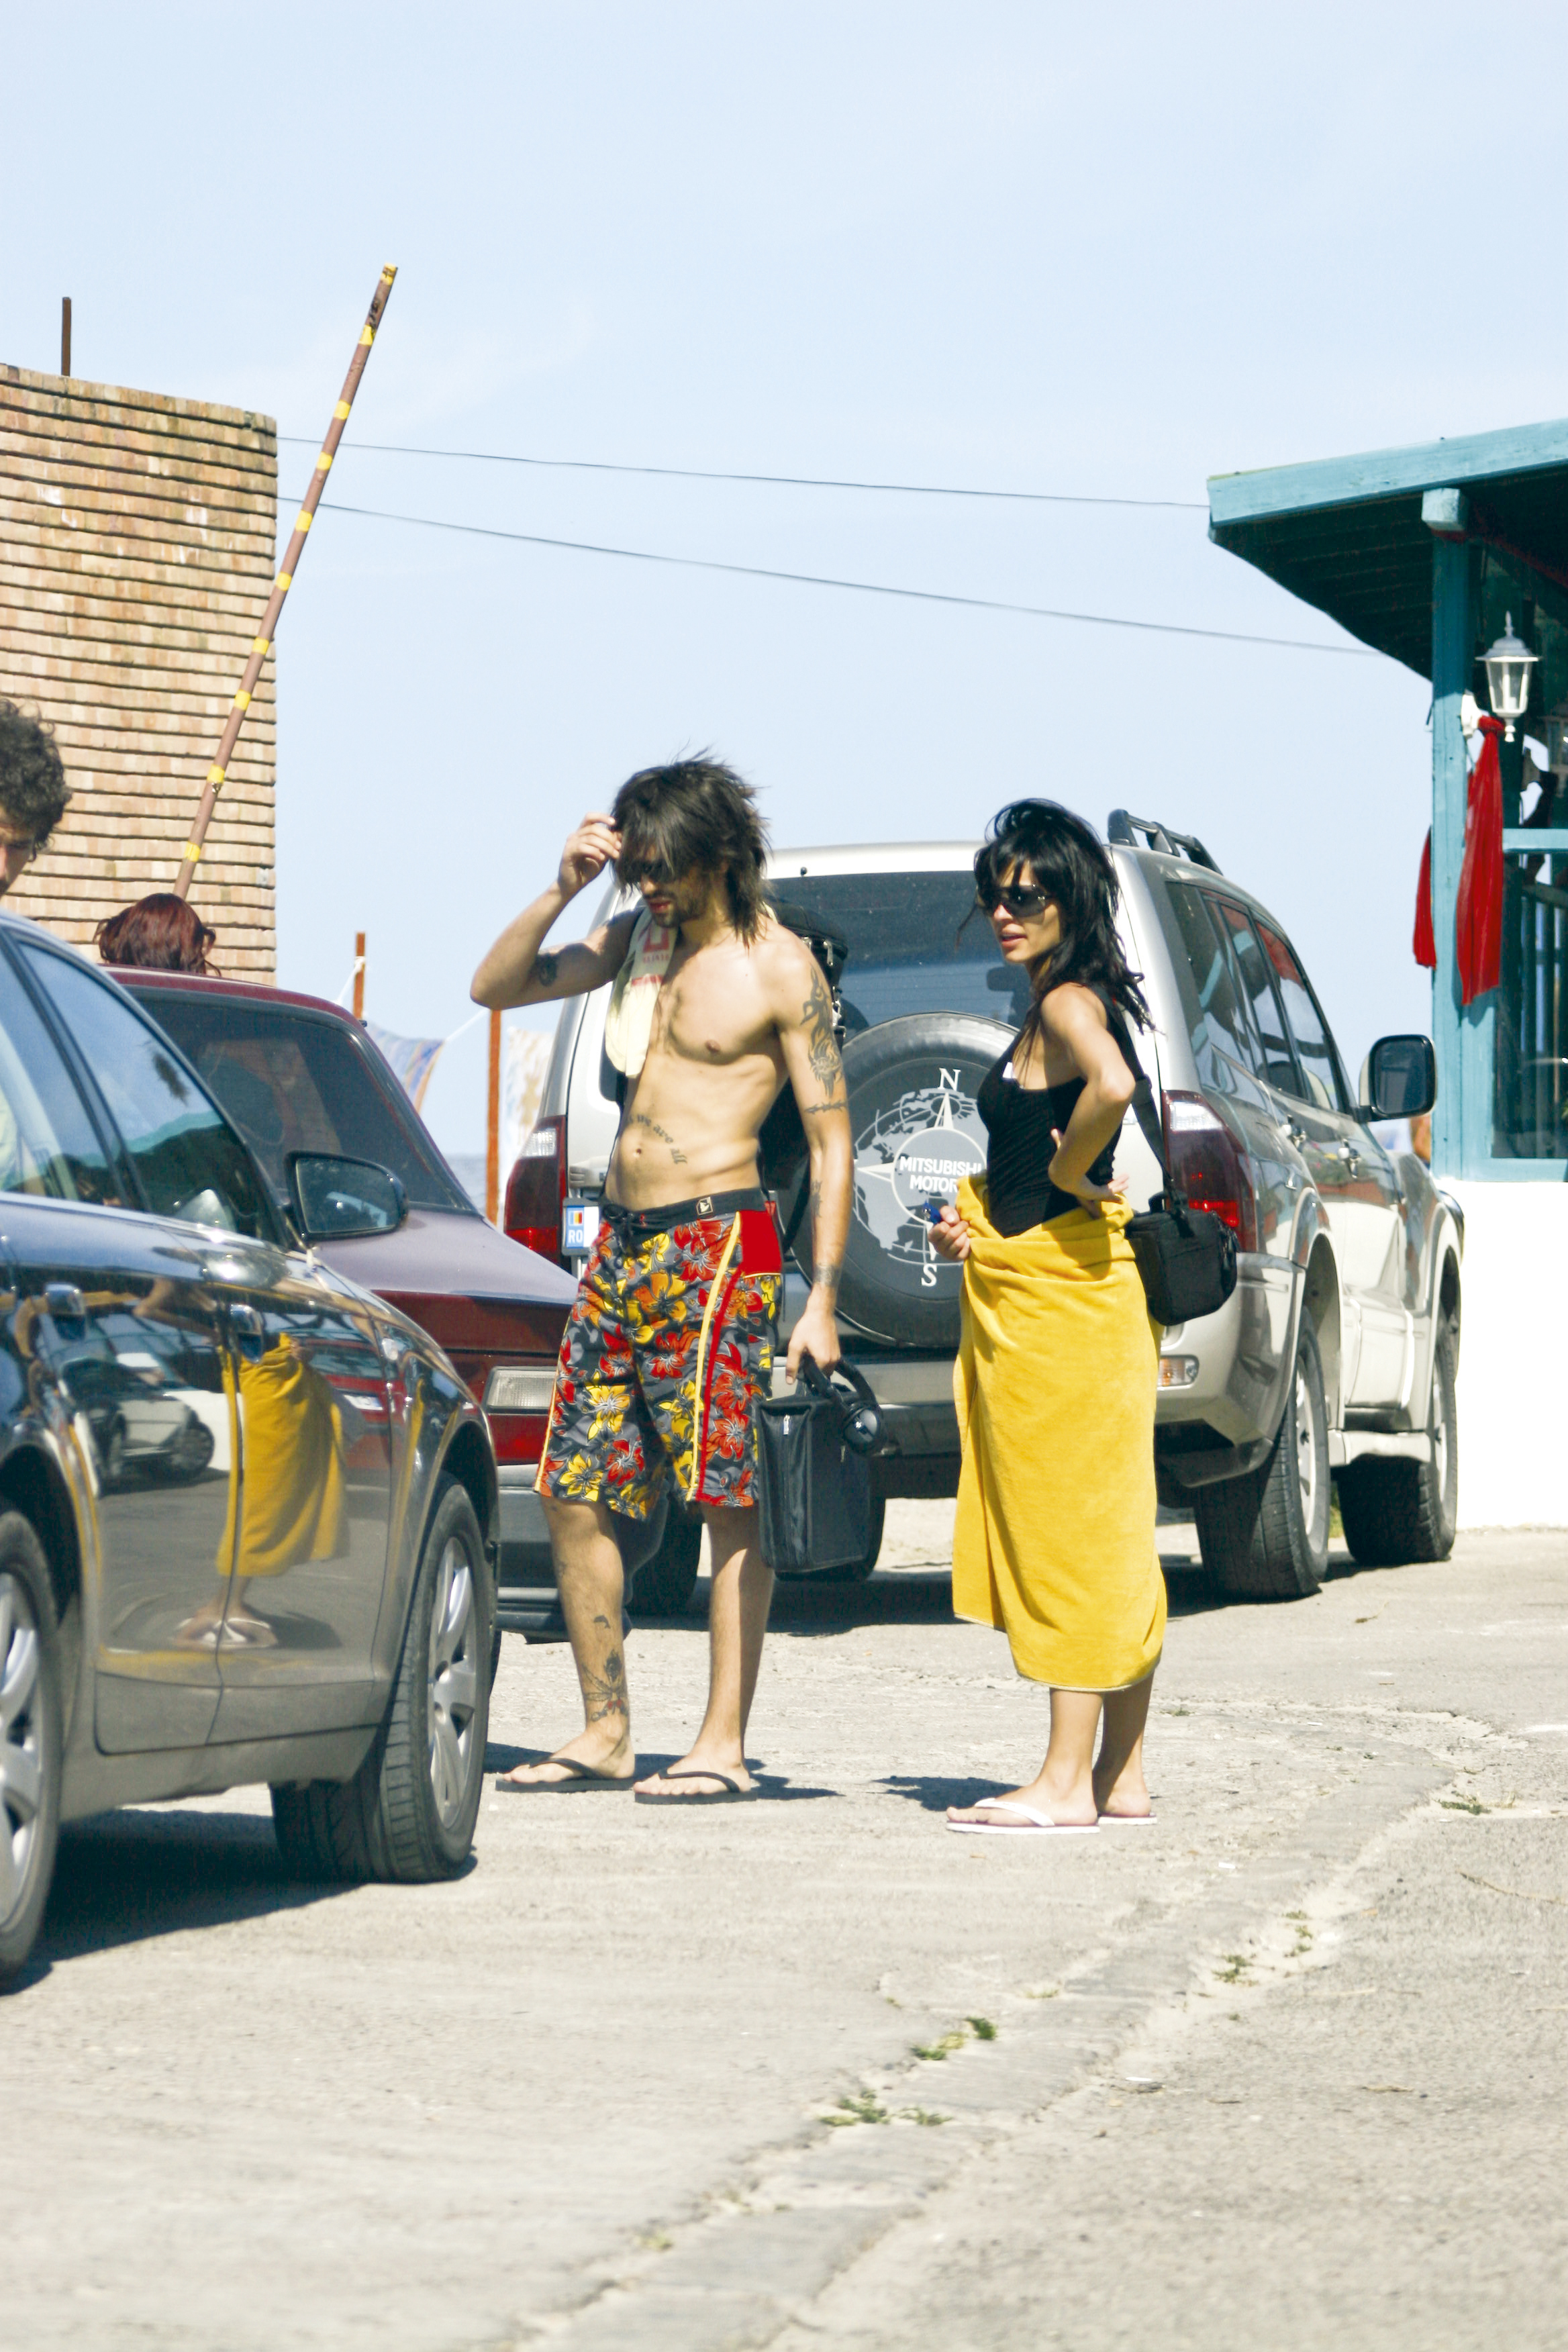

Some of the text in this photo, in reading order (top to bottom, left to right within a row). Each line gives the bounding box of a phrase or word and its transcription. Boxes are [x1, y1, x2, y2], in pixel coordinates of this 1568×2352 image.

[938, 1067, 961, 1091] N
[899, 1155, 982, 1177] MITSUBISHI
[909, 1174, 959, 1193] MOTOR
[568, 1229, 583, 1244] RO
[921, 1263, 937, 1287] S
